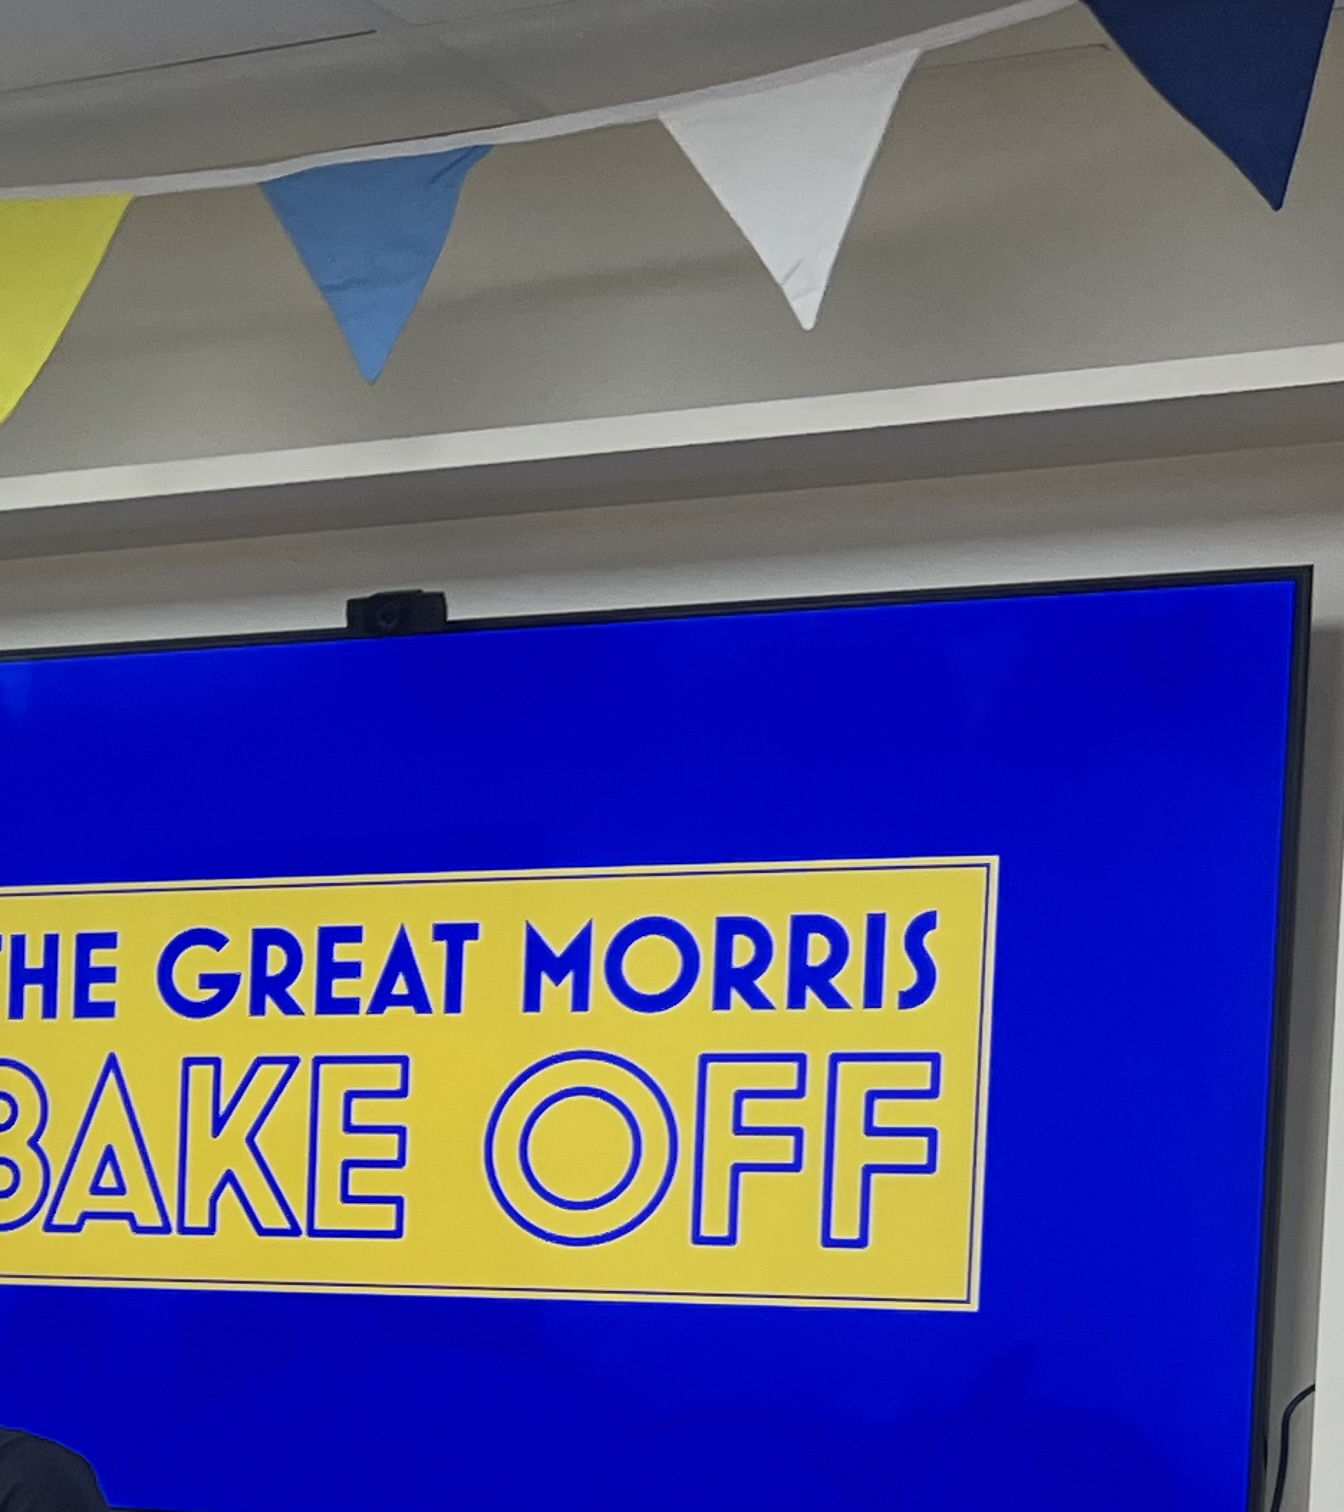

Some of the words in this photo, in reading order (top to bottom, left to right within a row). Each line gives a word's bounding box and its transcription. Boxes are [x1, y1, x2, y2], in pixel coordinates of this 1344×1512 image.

[156, 922, 479, 1018] GREAT
[525, 910, 936, 1014] MORRIS
[485, 1049, 940, 1248] OFF
